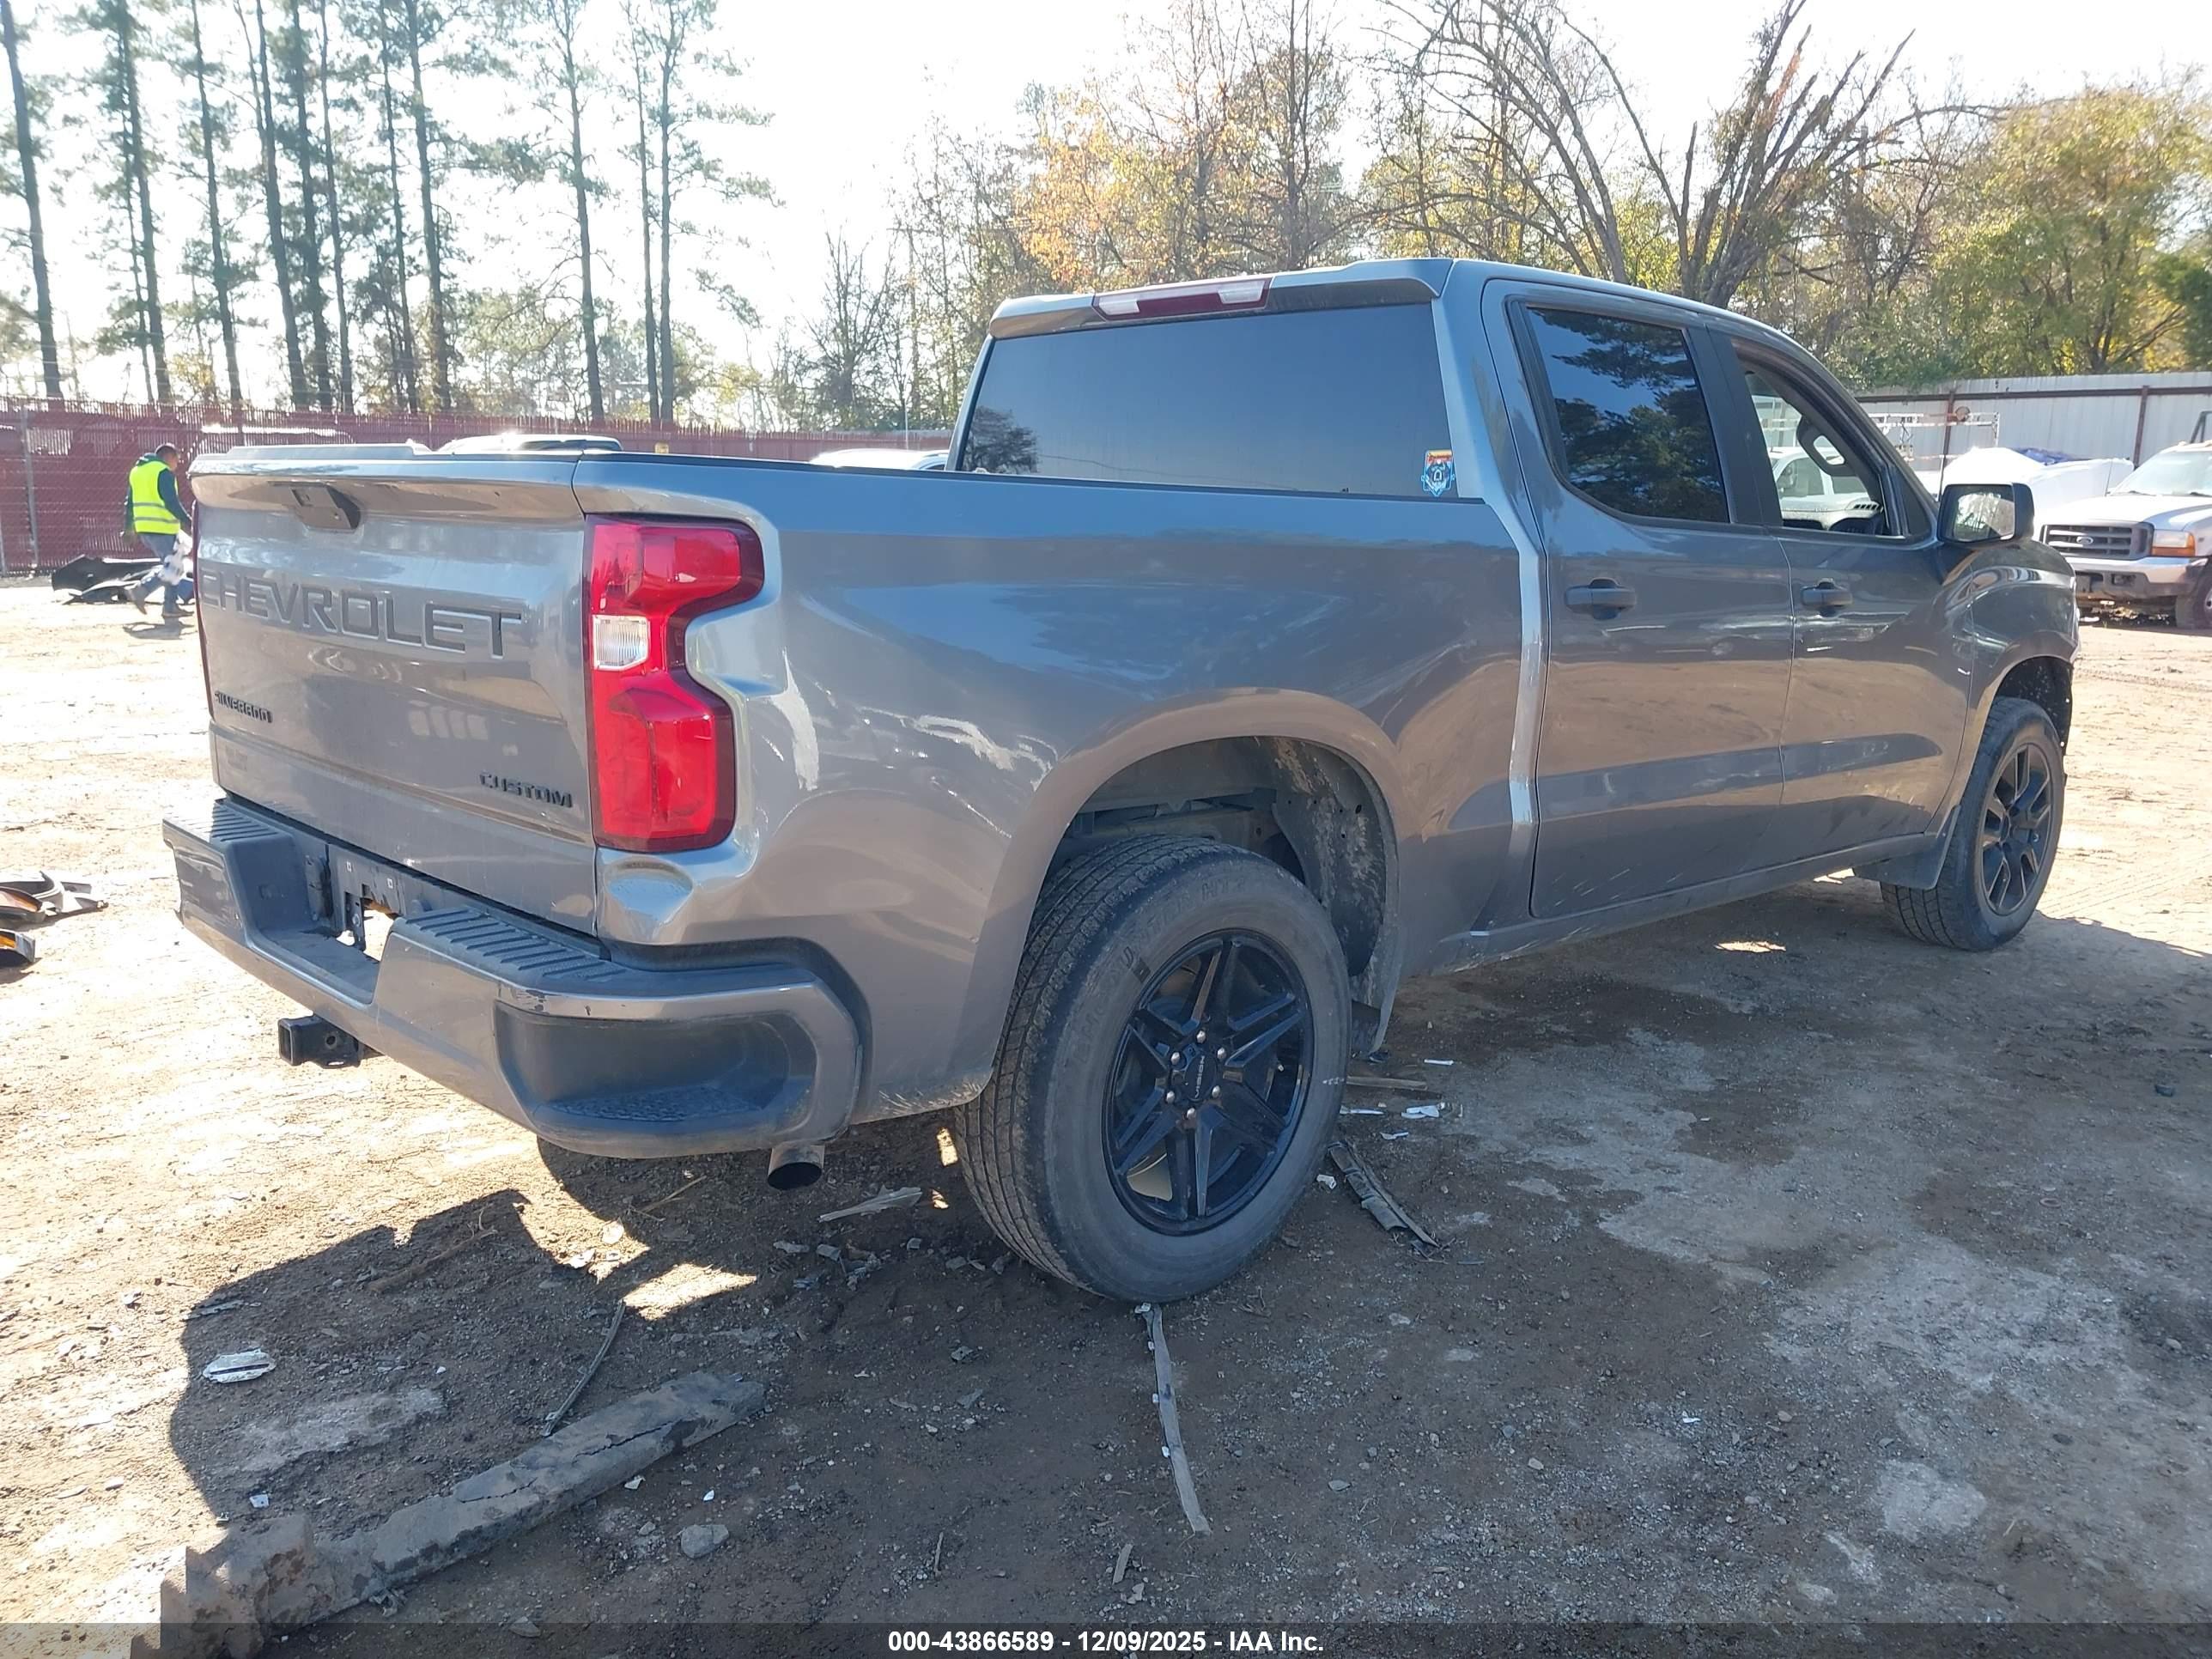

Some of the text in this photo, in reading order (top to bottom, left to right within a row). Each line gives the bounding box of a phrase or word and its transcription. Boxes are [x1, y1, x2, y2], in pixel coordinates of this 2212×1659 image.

[198, 568, 522, 659] CHEVROLET
[214, 690, 272, 723] SILVERADO
[479, 772, 573, 808] CUSTOM
